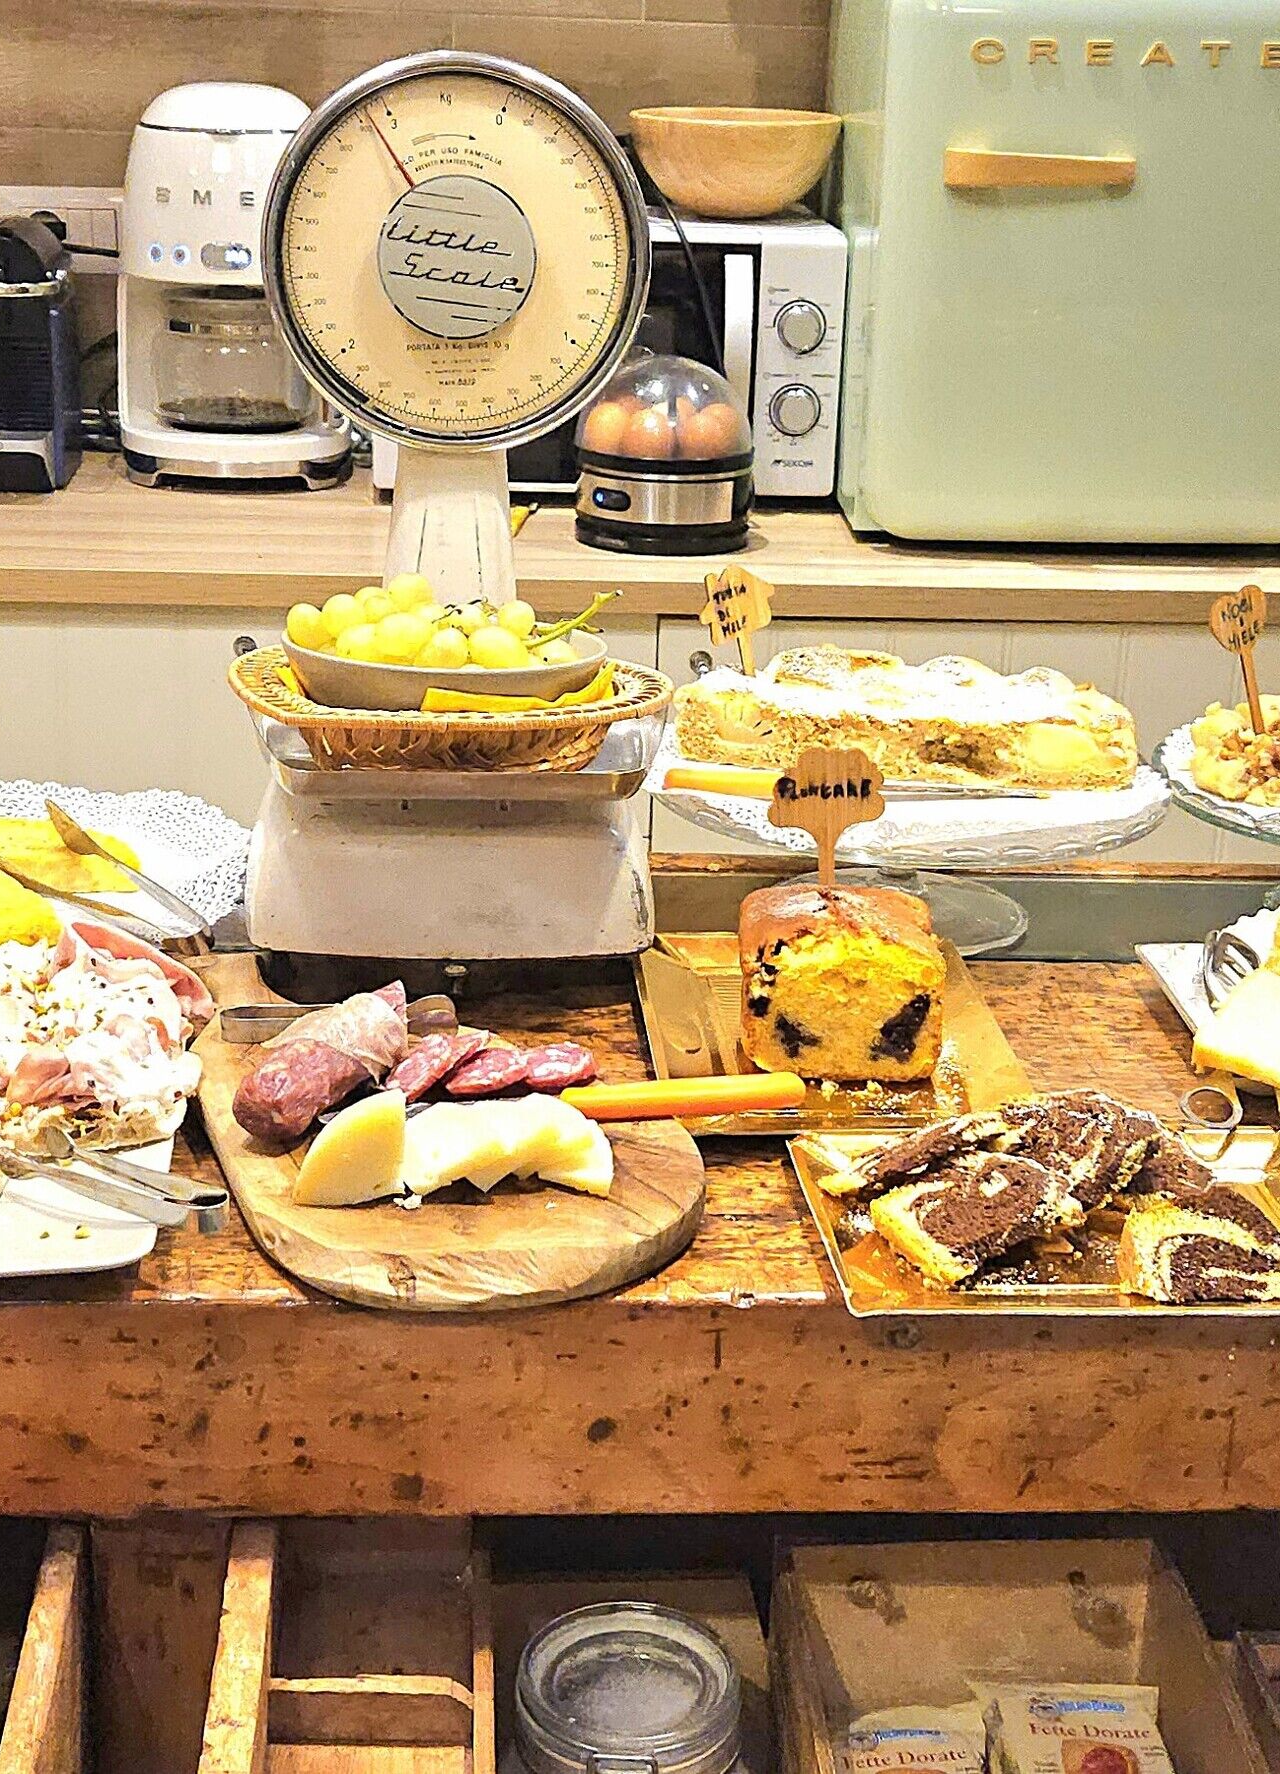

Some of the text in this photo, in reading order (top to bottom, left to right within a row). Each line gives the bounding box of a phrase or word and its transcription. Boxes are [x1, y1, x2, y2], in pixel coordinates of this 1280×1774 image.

[440, 91, 452, 105] Kg
[390, 118, 398, 130] 3
[495, 114, 503, 126] 0
[464, 148, 502, 166] FAMIGLIA
[388, 252, 524, 293] Scale
[564, 331, 569, 341] 1
[348, 339, 355, 350] 2
[406, 343, 440, 351] PORTATA
[1029, 1722, 1150, 1738] Fette Dorate
[898, 1750, 967, 1765] Dorate
